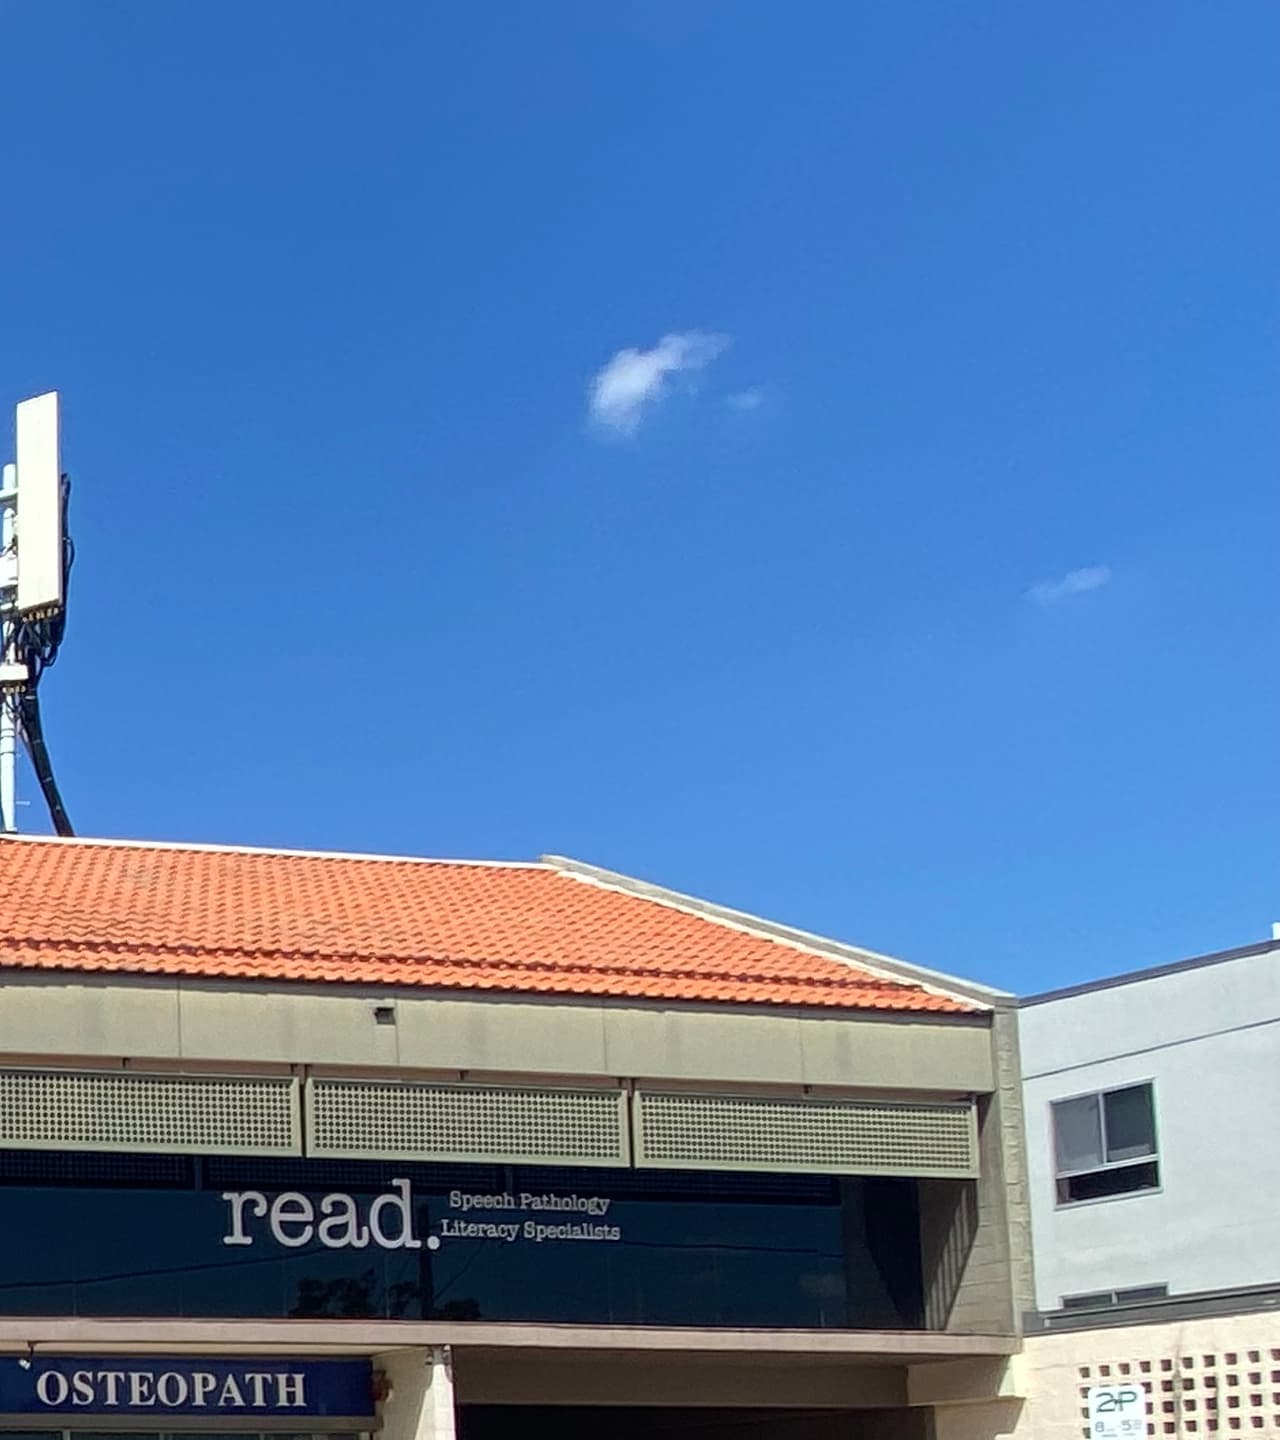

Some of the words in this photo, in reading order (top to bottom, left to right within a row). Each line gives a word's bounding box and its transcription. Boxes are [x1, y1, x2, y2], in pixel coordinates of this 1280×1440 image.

[222, 1177, 440, 1249] read.
[449, 1190, 516, 1210] Speech
[519, 1192, 611, 1216] Pathology
[440, 1218, 522, 1240] Literacy
[523, 1220, 621, 1242] Specialists
[36, 1369, 308, 1407] OSTEOPATH
[1095, 1390, 1138, 1413] 2P
